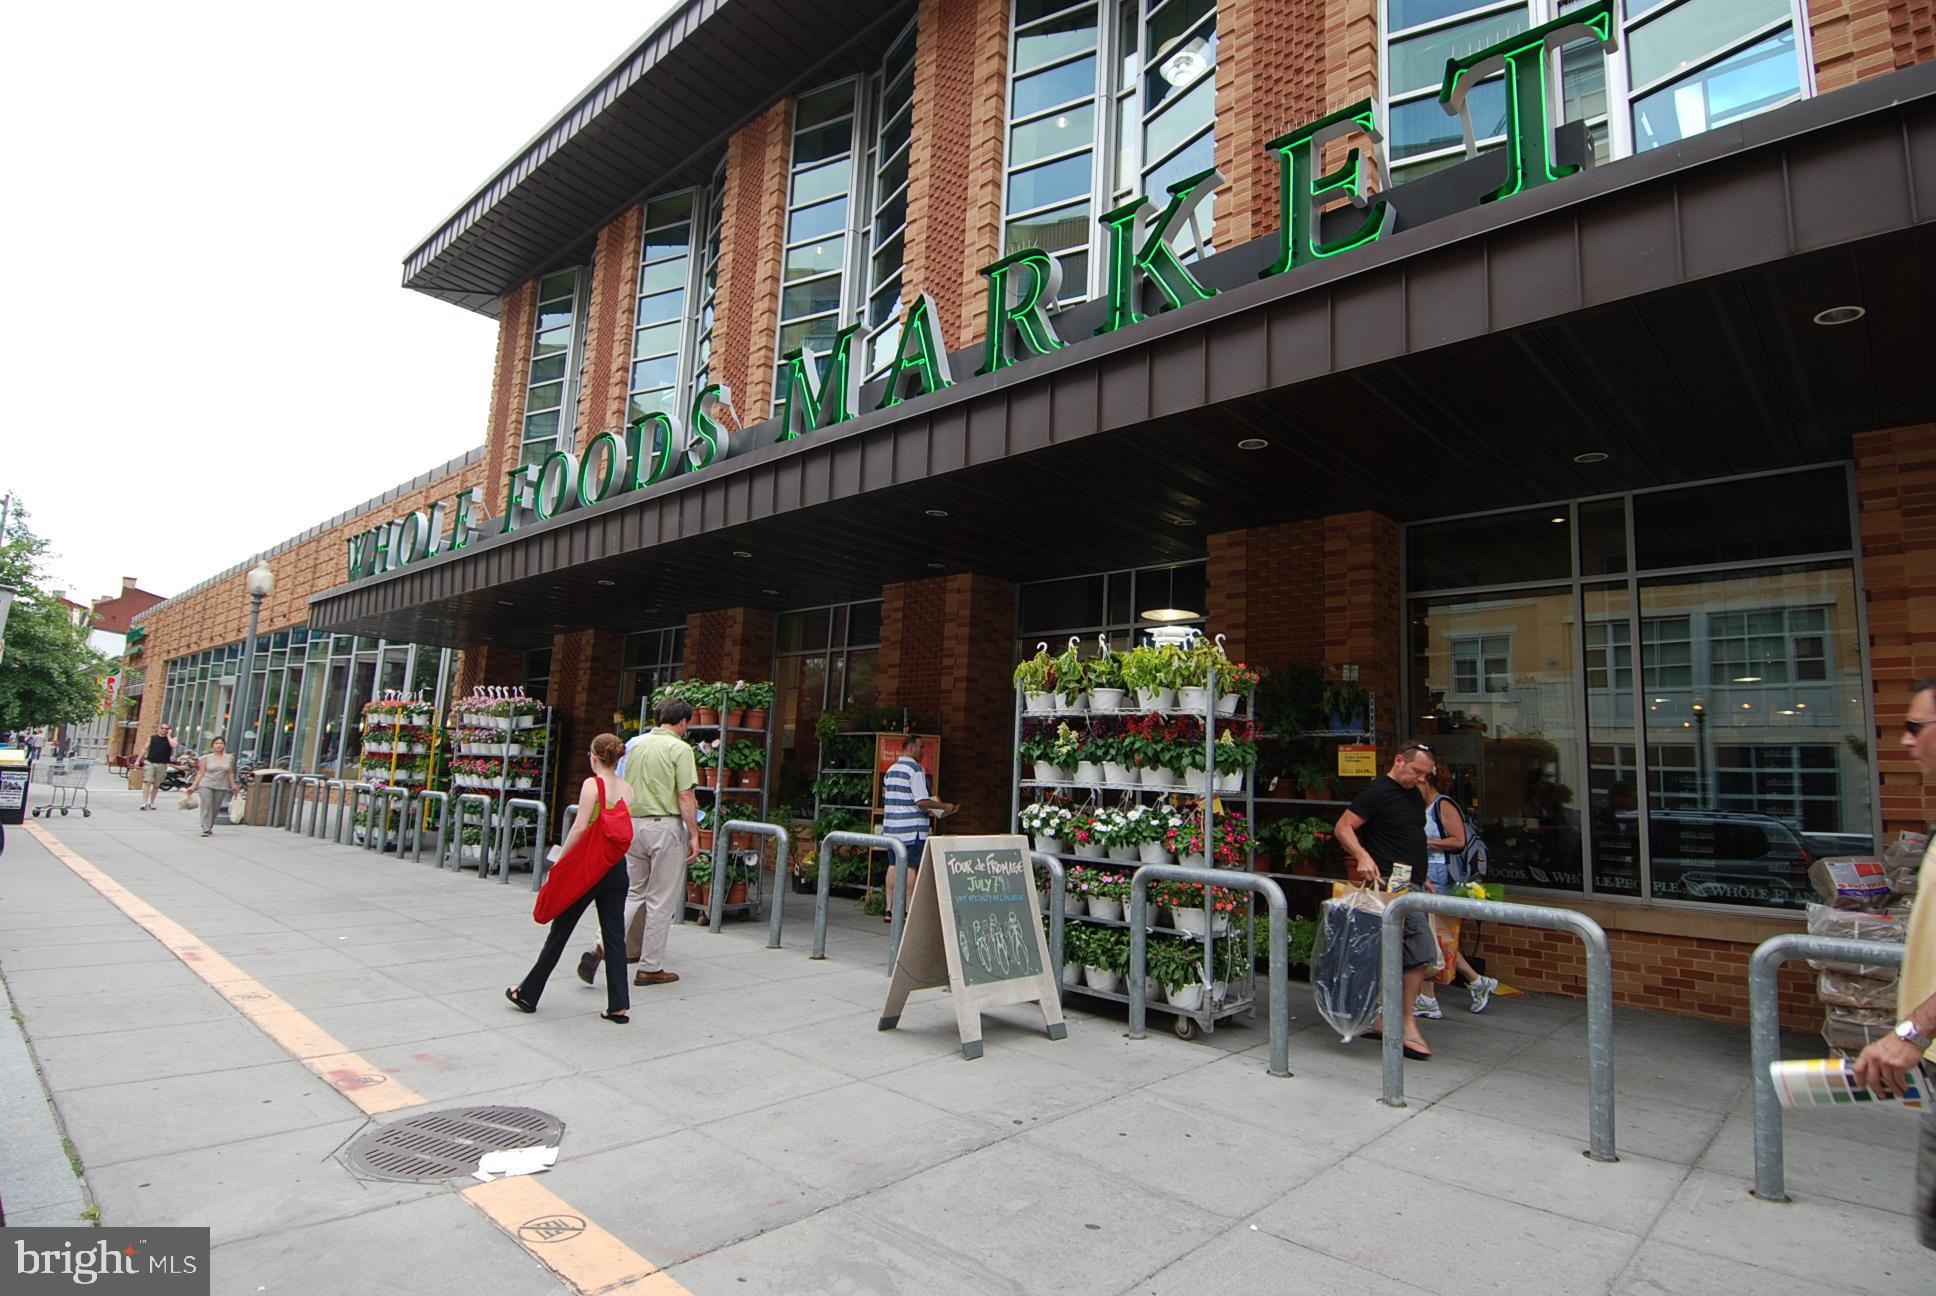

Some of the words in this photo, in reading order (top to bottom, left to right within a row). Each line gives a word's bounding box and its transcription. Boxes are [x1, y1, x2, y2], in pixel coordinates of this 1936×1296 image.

[347, 487, 483, 583] WHOLE
[500, 383, 730, 533] FOODS
[774, 4, 1620, 443] MARKET
[947, 857, 975, 875] TOUR
[975, 858, 986, 871] de
[986, 852, 1025, 876] FROMAGE
[967, 876, 992, 893] JULY
[1711, 884, 1769, 900] WHOLE
